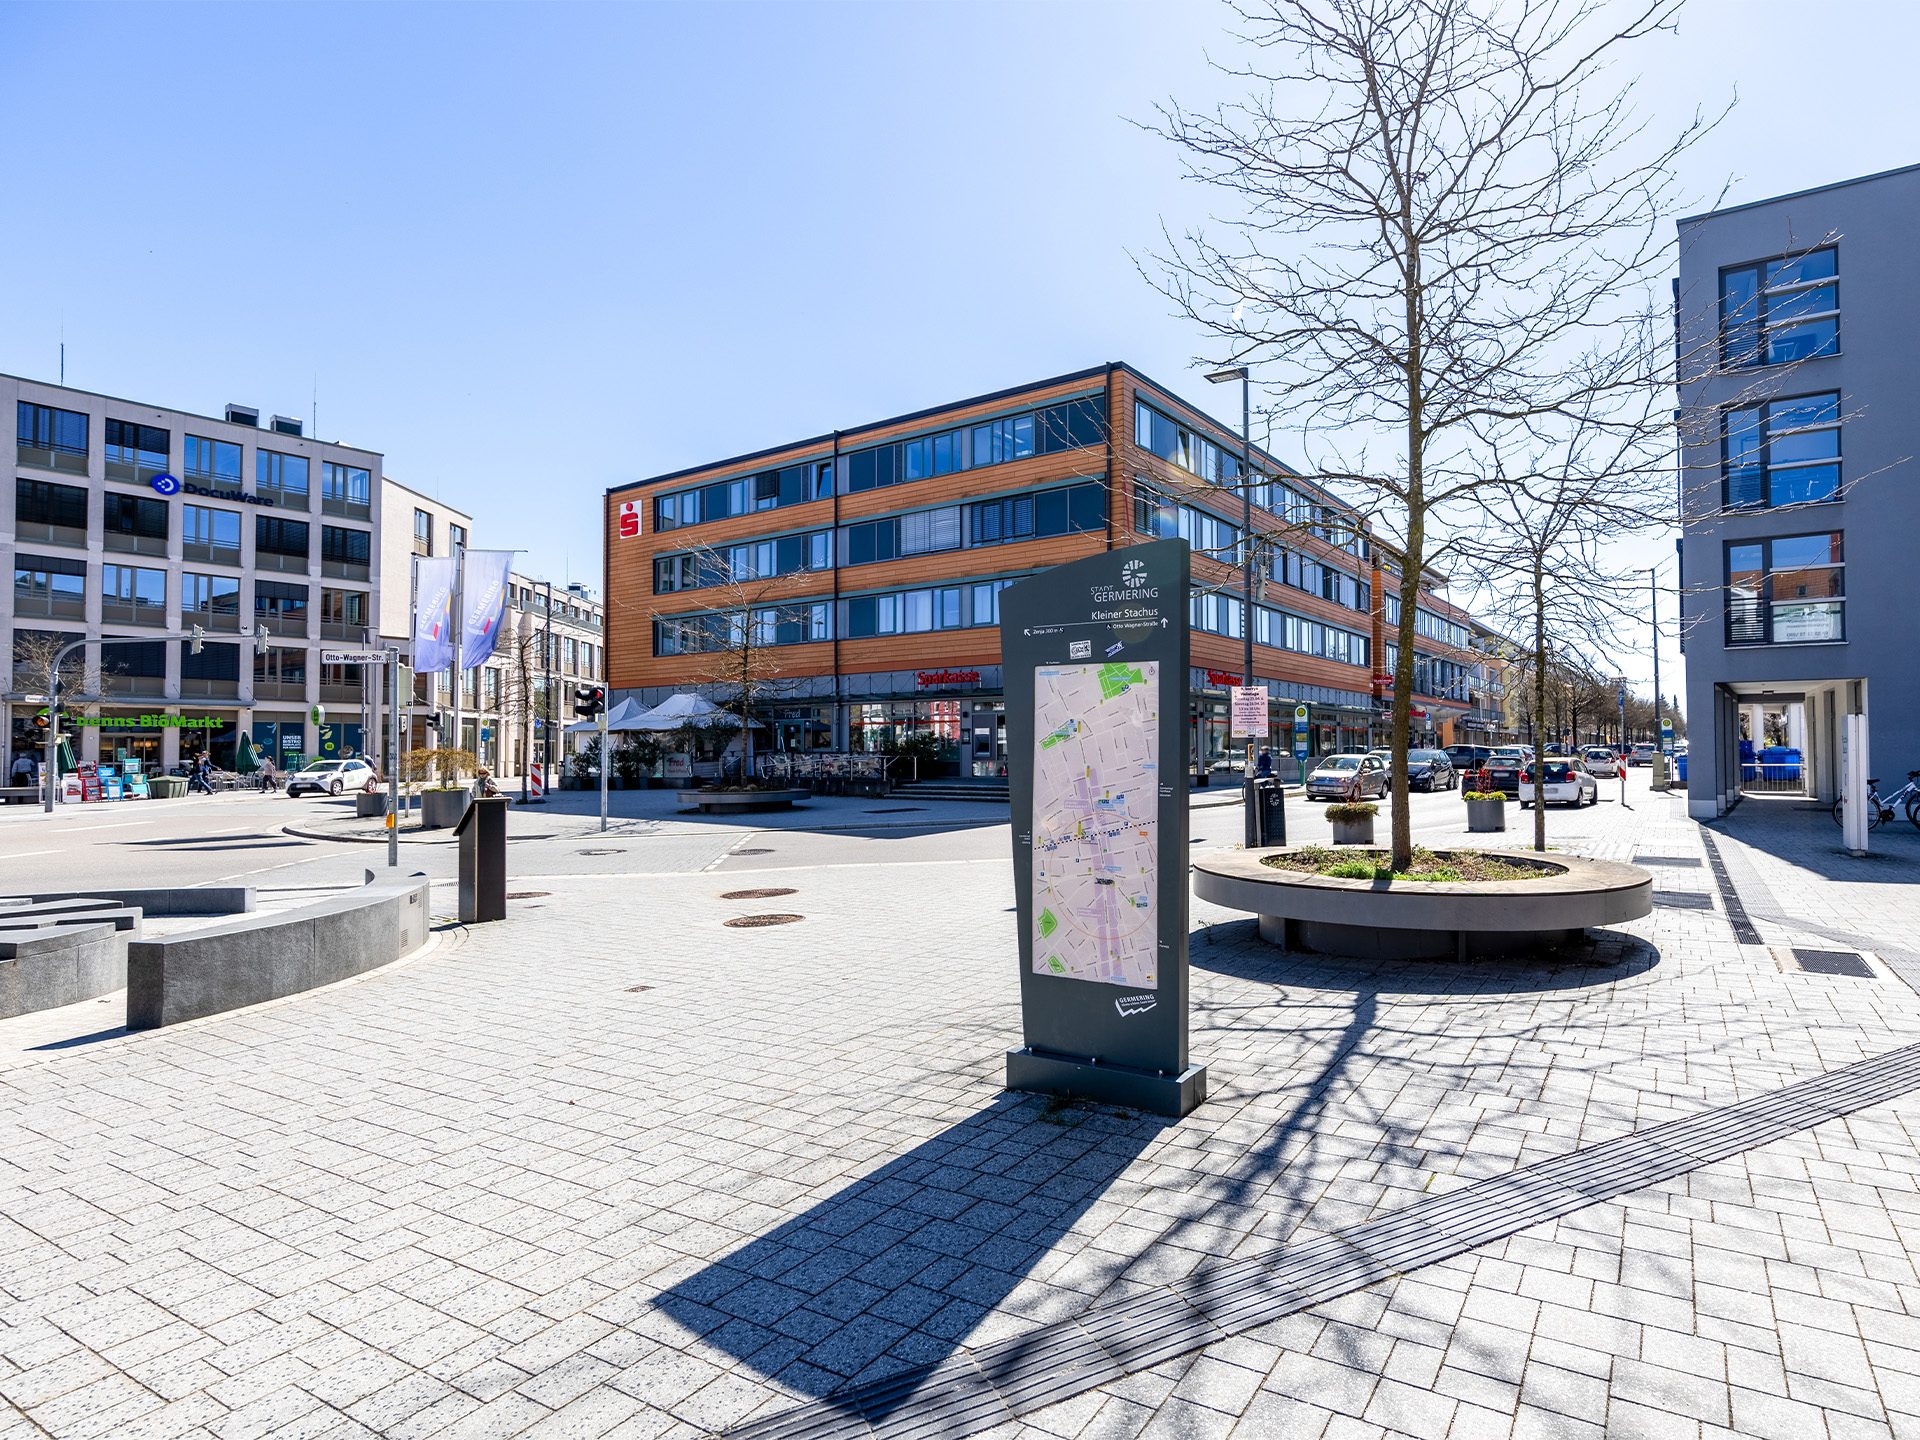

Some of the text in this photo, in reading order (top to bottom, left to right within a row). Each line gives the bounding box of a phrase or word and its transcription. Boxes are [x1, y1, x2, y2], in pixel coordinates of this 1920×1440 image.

[184, 482, 274, 506] DocuWare
[1090, 585, 1114, 595] STADT
[1094, 587, 1159, 603] GERMERING
[1091, 607, 1159, 620] Kleiner Stachus
[325, 653, 384, 662] Otto-Wagner-Str.
[917, 669, 979, 688] Sparkasse
[1119, 993, 1155, 1004] GERMERING
